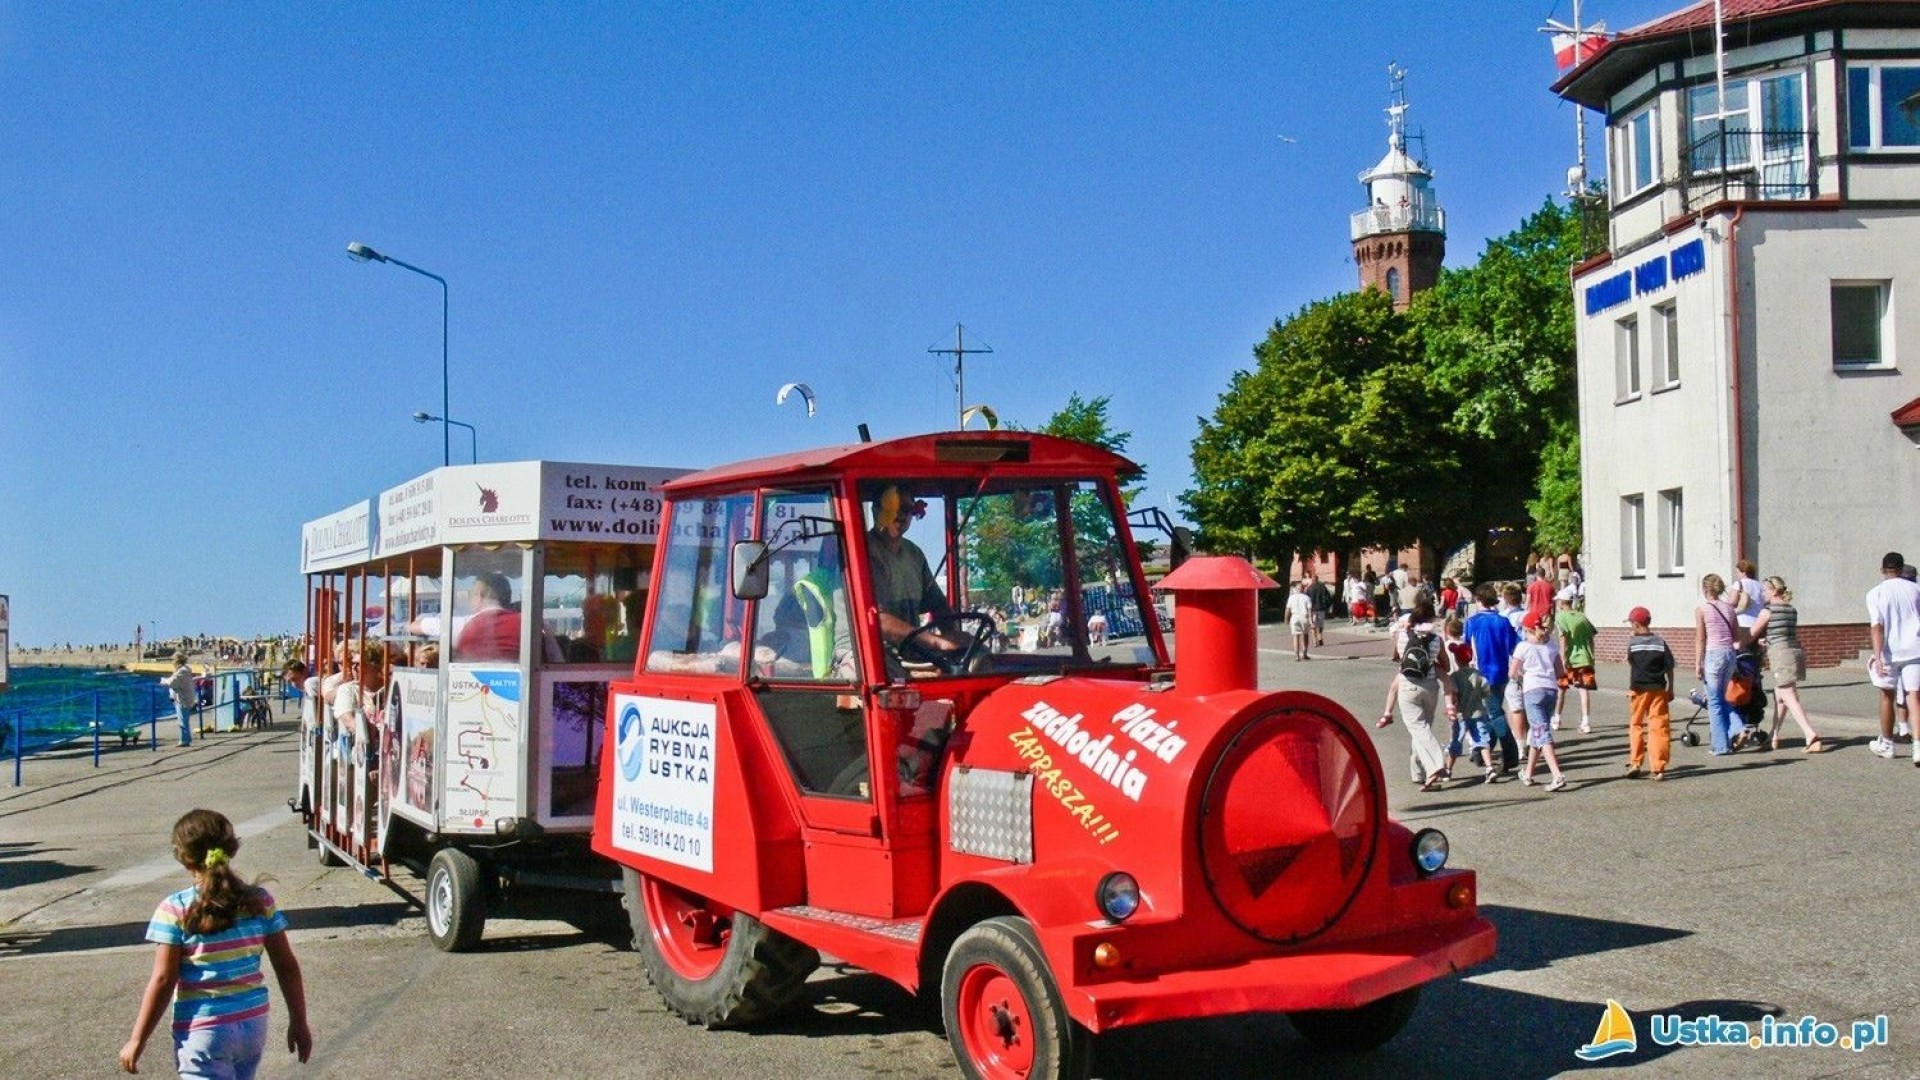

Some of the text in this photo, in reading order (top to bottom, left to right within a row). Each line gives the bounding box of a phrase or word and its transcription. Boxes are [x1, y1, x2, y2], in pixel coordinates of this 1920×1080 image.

[565, 474, 598, 490] tel.
[566, 494, 602, 510] fax:
[610, 497, 662, 514] (+48)
[448, 516, 481, 526] DOLINA
[452, 681, 480, 689] USTKA
[651, 717, 710, 739] AUKCJA
[1110, 702, 1188, 765] Plaża
[650, 738, 709, 762] RYBNA
[1020, 700, 1149, 803] zachodnia
[649, 759, 709, 783] USTKA
[630, 796, 694, 827] Westerplatte
[696, 811, 709, 830] 4a
[622, 822, 637, 839] tel.
[672, 833, 686, 852] 20
[688, 837, 701, 856] 10
